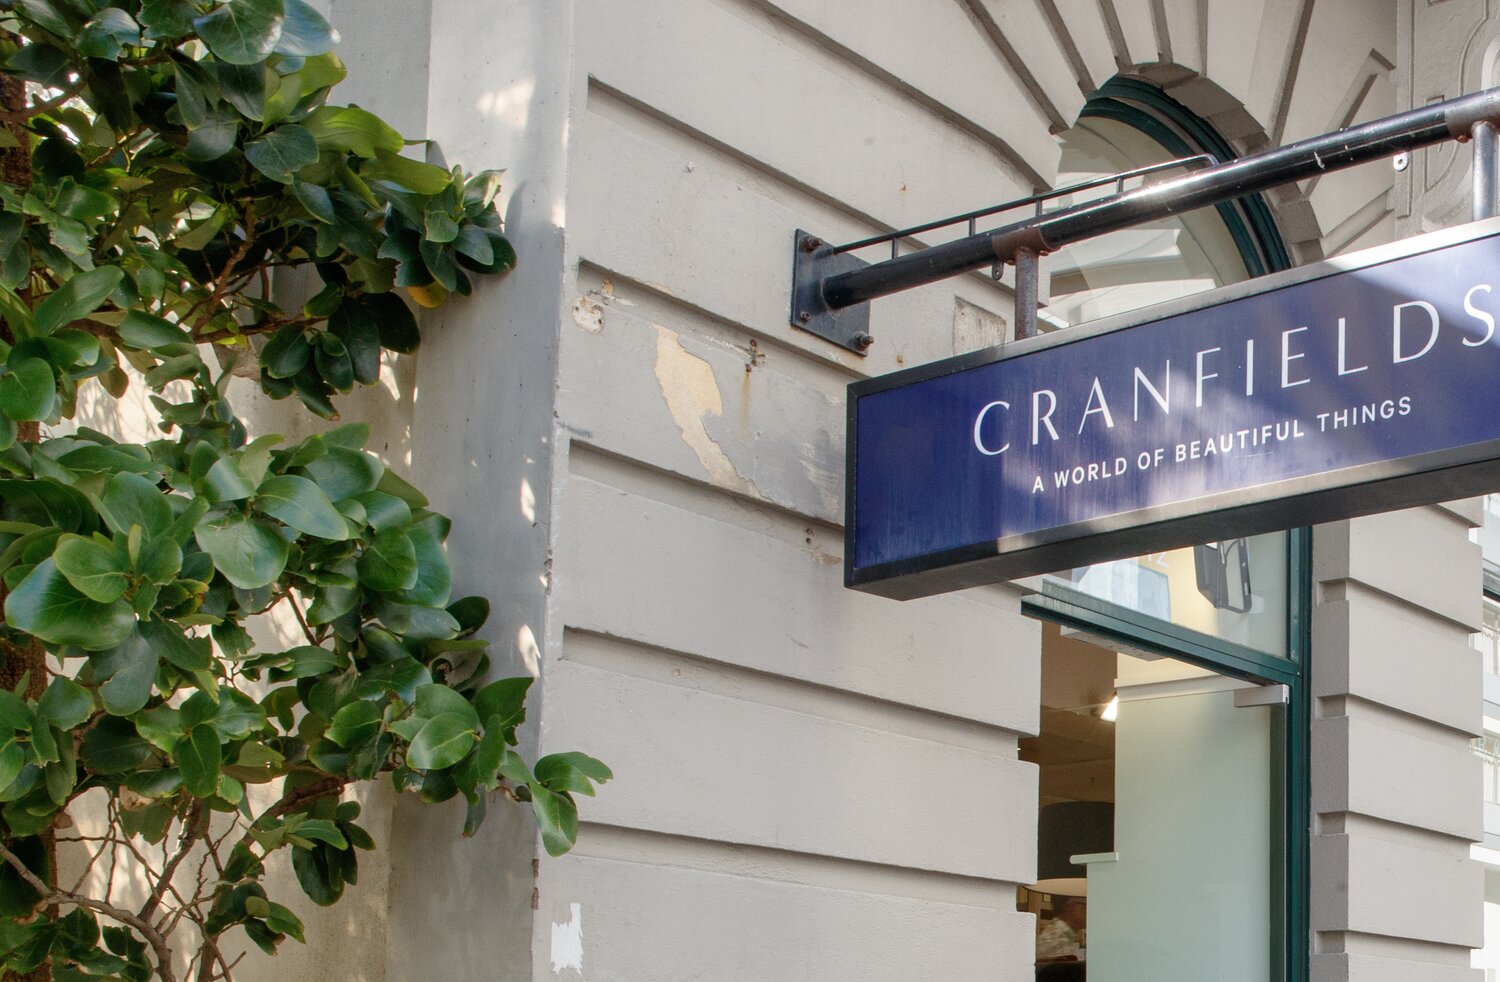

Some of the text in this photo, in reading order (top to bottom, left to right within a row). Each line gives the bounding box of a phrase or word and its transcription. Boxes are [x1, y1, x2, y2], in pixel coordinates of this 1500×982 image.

[973, 283, 1496, 457] CRANFIELDS
[1032, 395, 1412, 494] A WORLD OF BEAUTIFUL THINGS
